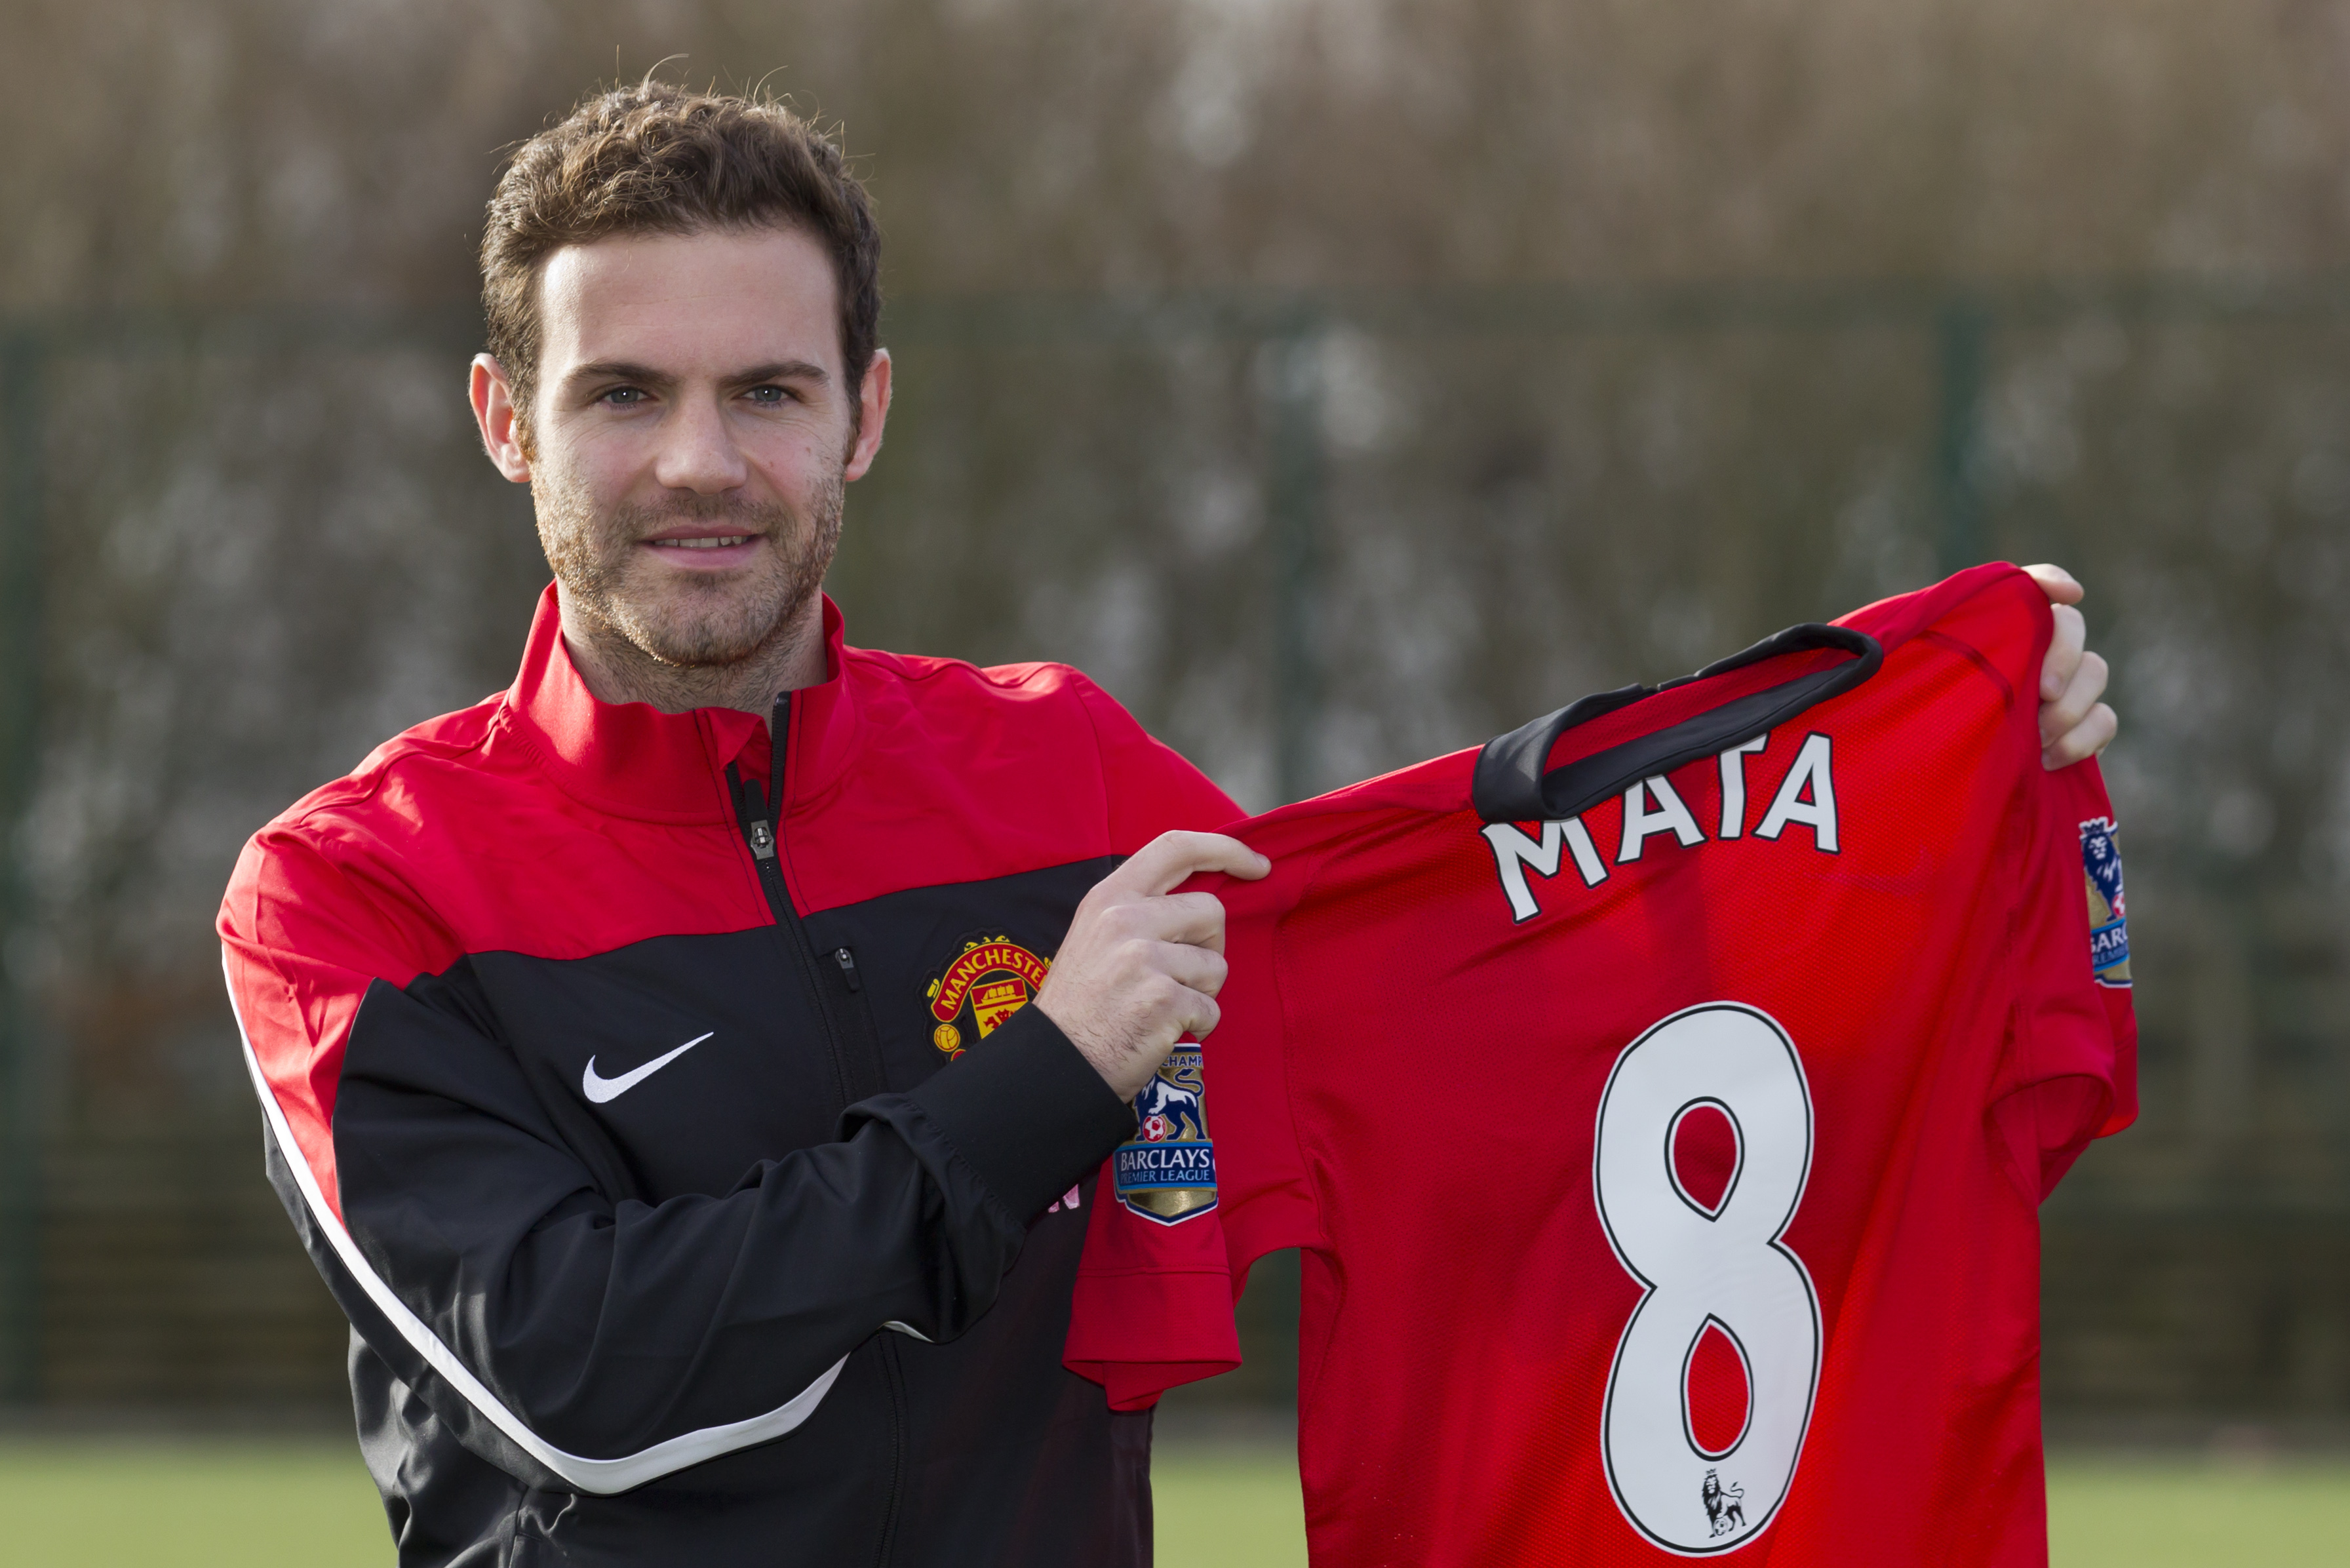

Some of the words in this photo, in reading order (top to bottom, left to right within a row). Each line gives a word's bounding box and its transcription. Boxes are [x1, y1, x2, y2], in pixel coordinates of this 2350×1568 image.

[1479, 730, 1841, 925] MATA
[1120, 1148, 1210, 1171] BARCLAYS
[1120, 1171, 1156, 1185] PREMIER
[1160, 1169, 1210, 1181] LEAGUE
[1592, 1000, 1823, 1558] 8
